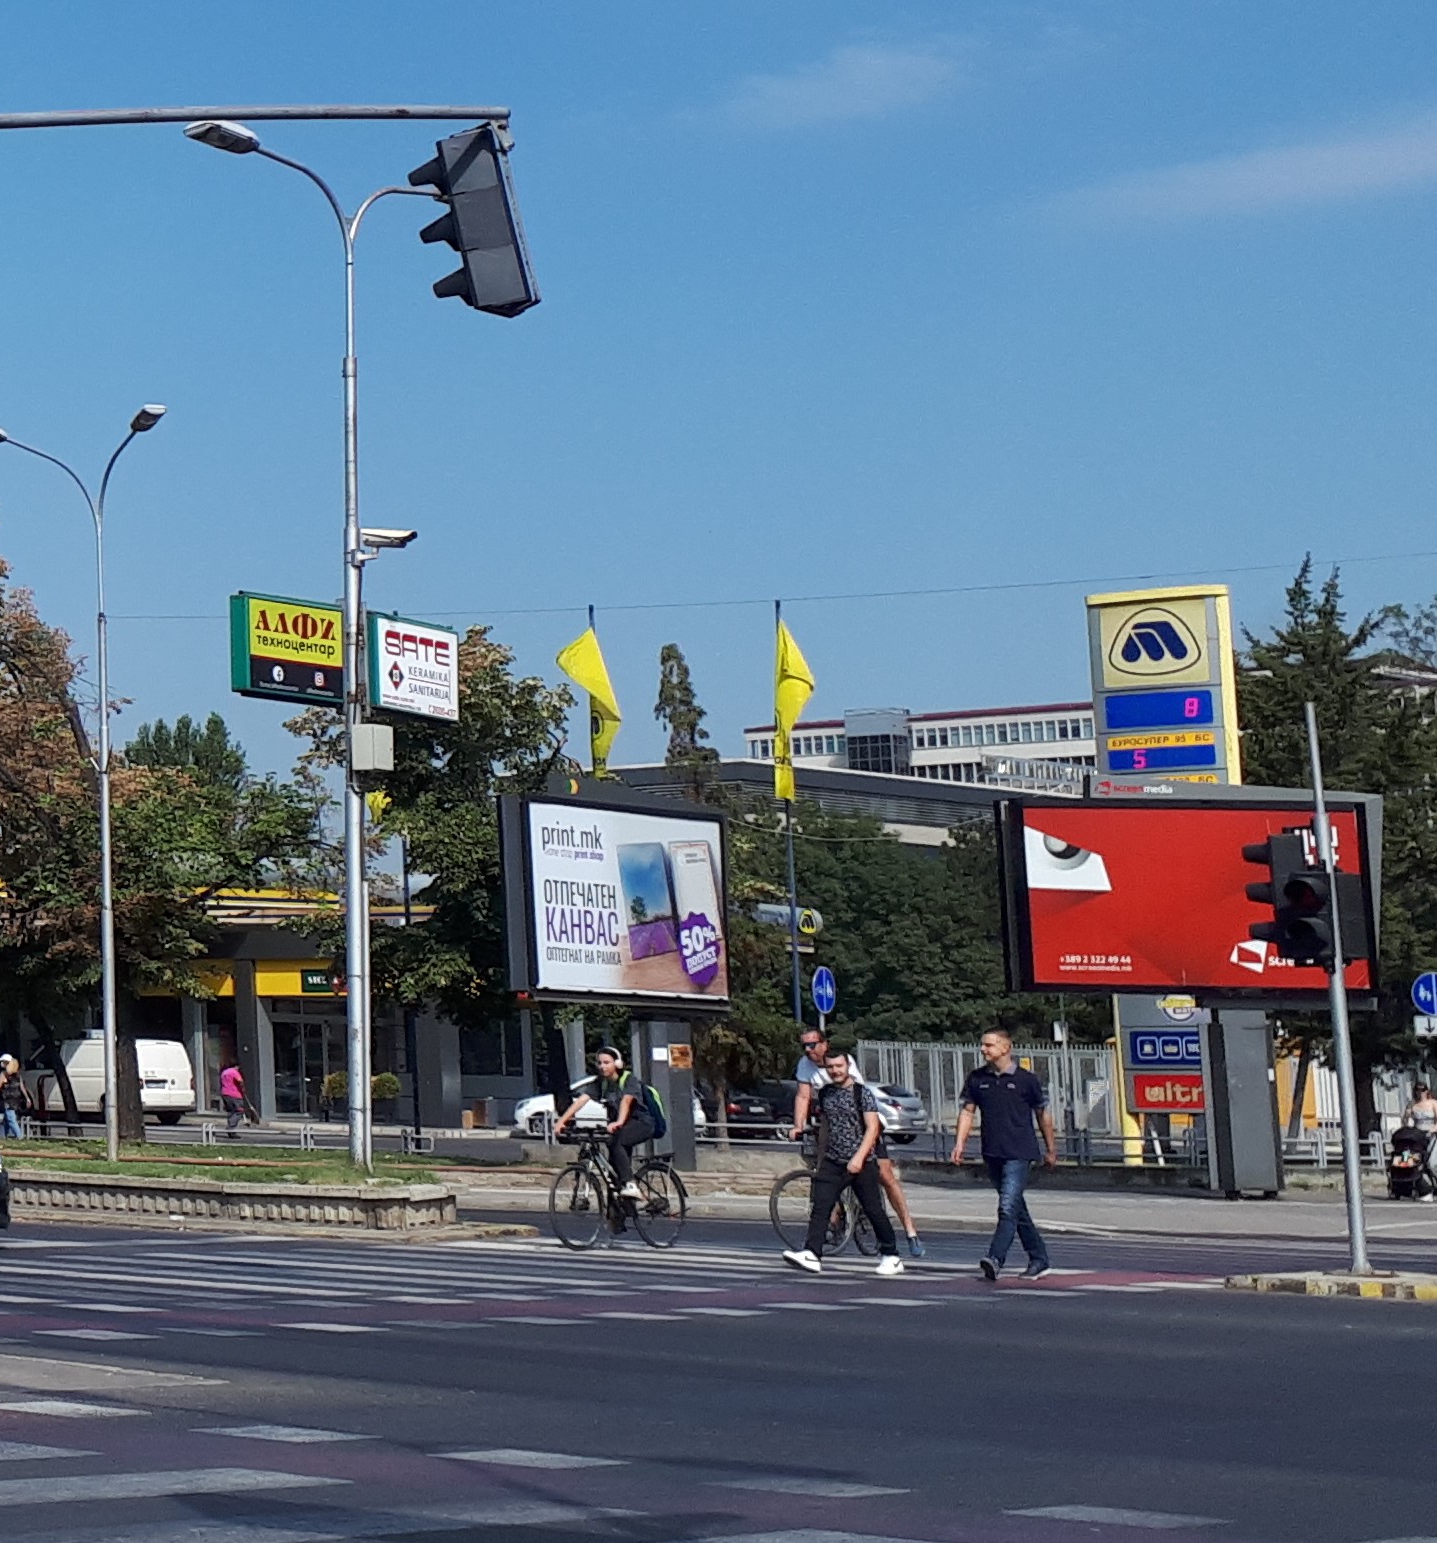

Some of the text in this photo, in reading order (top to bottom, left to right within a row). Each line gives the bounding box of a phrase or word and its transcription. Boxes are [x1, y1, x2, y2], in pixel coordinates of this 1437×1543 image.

[255, 609, 337, 641] АЛФИ
[256, 634, 335, 659] техноцентар
[385, 629, 450, 667] SATE
[408, 666, 449, 683] KERAMIKA
[1112, 735, 1169, 748] ЕУРОСУПЕР
[1132, 748, 1147, 769] 5
[542, 820, 603, 851] print.mk
[544, 879, 616, 909] ОТПЕЧАТЕН
[545, 906, 620, 947] КАНВАС
[680, 925, 716, 957] 50%
[584, 950, 596, 964] НА
[597, 950, 621, 966] РАМКА
